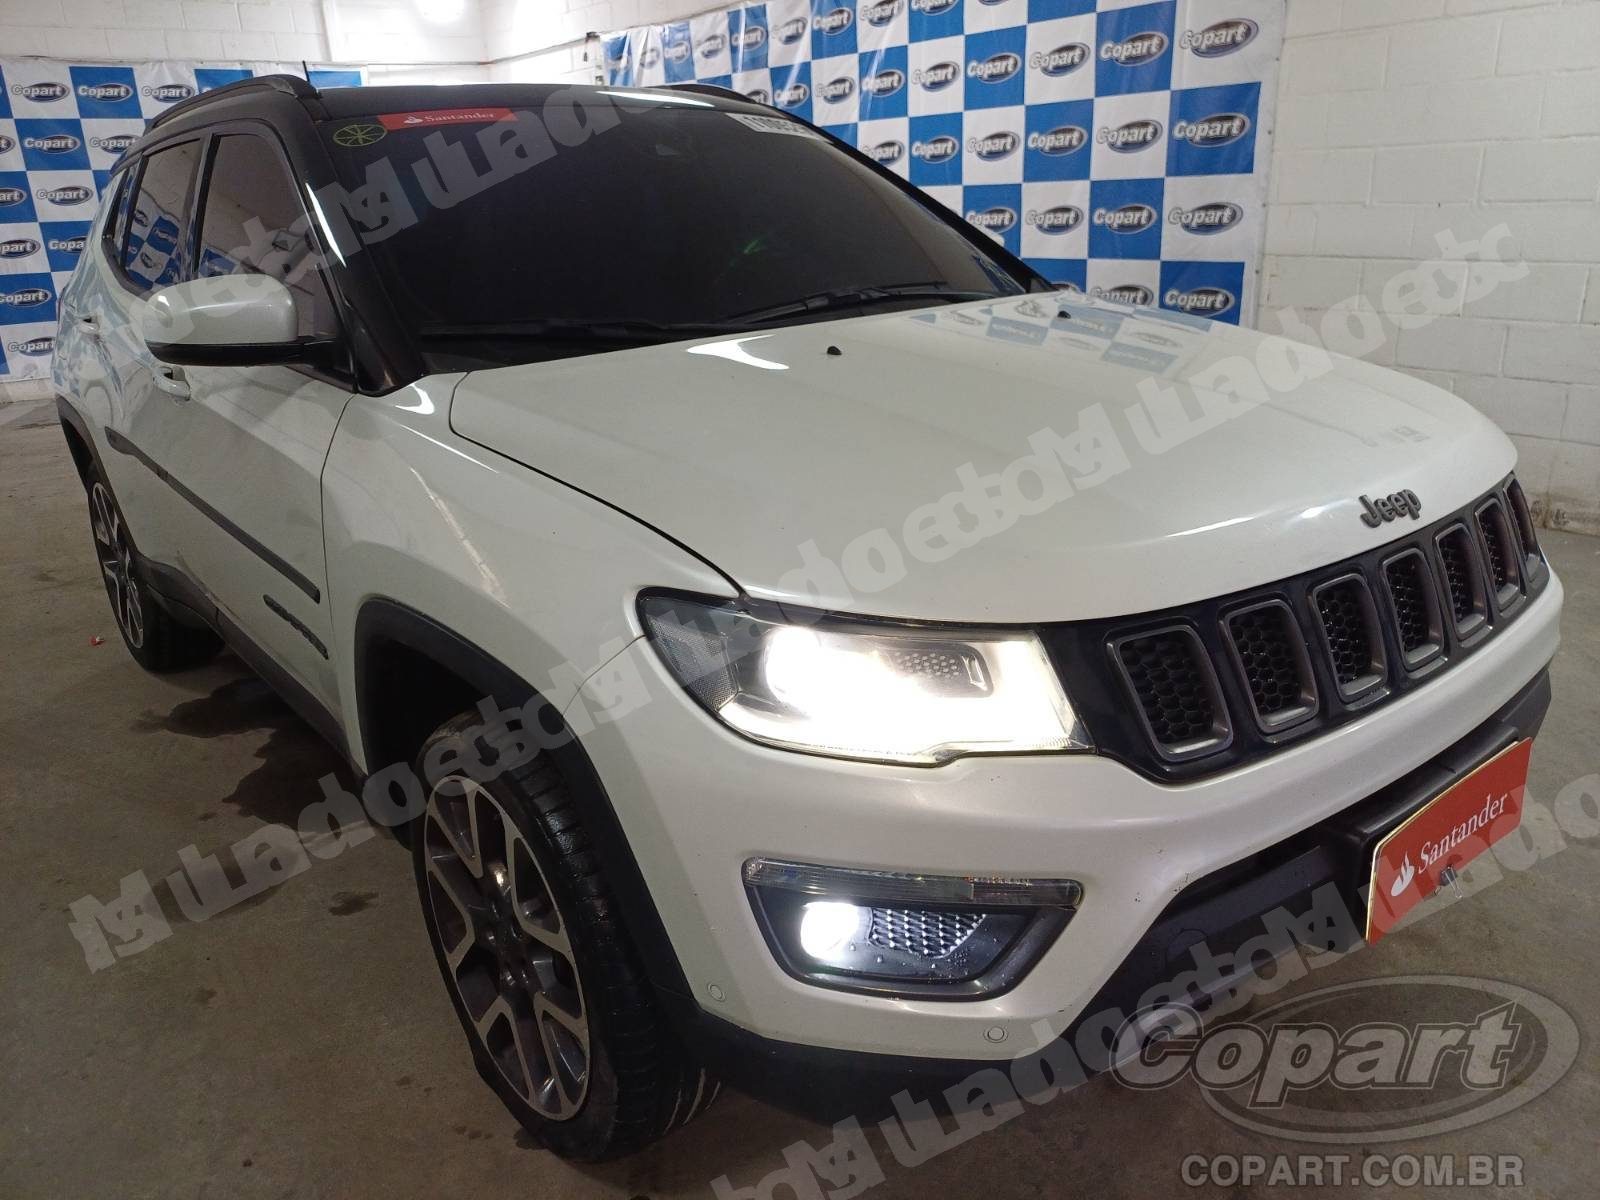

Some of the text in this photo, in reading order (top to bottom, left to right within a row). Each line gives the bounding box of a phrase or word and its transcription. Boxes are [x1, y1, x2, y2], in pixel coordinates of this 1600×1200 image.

[812, 12, 850, 31] Copart
[1179, 23, 1248, 51] Copart
[1030, 45, 1083, 69] Copart
[1100, 35, 1162, 61] Copart
[911, 65, 956, 87] Copart
[967, 57, 1015, 79] Copart
[12, 84, 63, 97] Copart
[78, 85, 128, 98] Copart
[142, 86, 189, 98] Copart
[425, 112, 496, 123] Santander
[1096, 123, 1154, 148] Copart
[1173, 117, 1241, 142] Copart
[24, 136, 74, 149] Copart
[912, 139, 954, 160] Copart
[967, 135, 1014, 156] Copart
[1028, 130, 1081, 151] Copart
[36, 188, 86, 202] Copart
[966, 208, 1012, 228] Copart
[1025, 208, 1077, 228] Copart
[1093, 206, 1149, 229] Copart
[1168, 205, 1232, 230] Copart
[48, 238, 85, 252] Copa
[1164, 289, 1226, 312] Copart
[1358, 489, 1421, 529] Jeep
[1418, 792, 1509, 875] Santander
